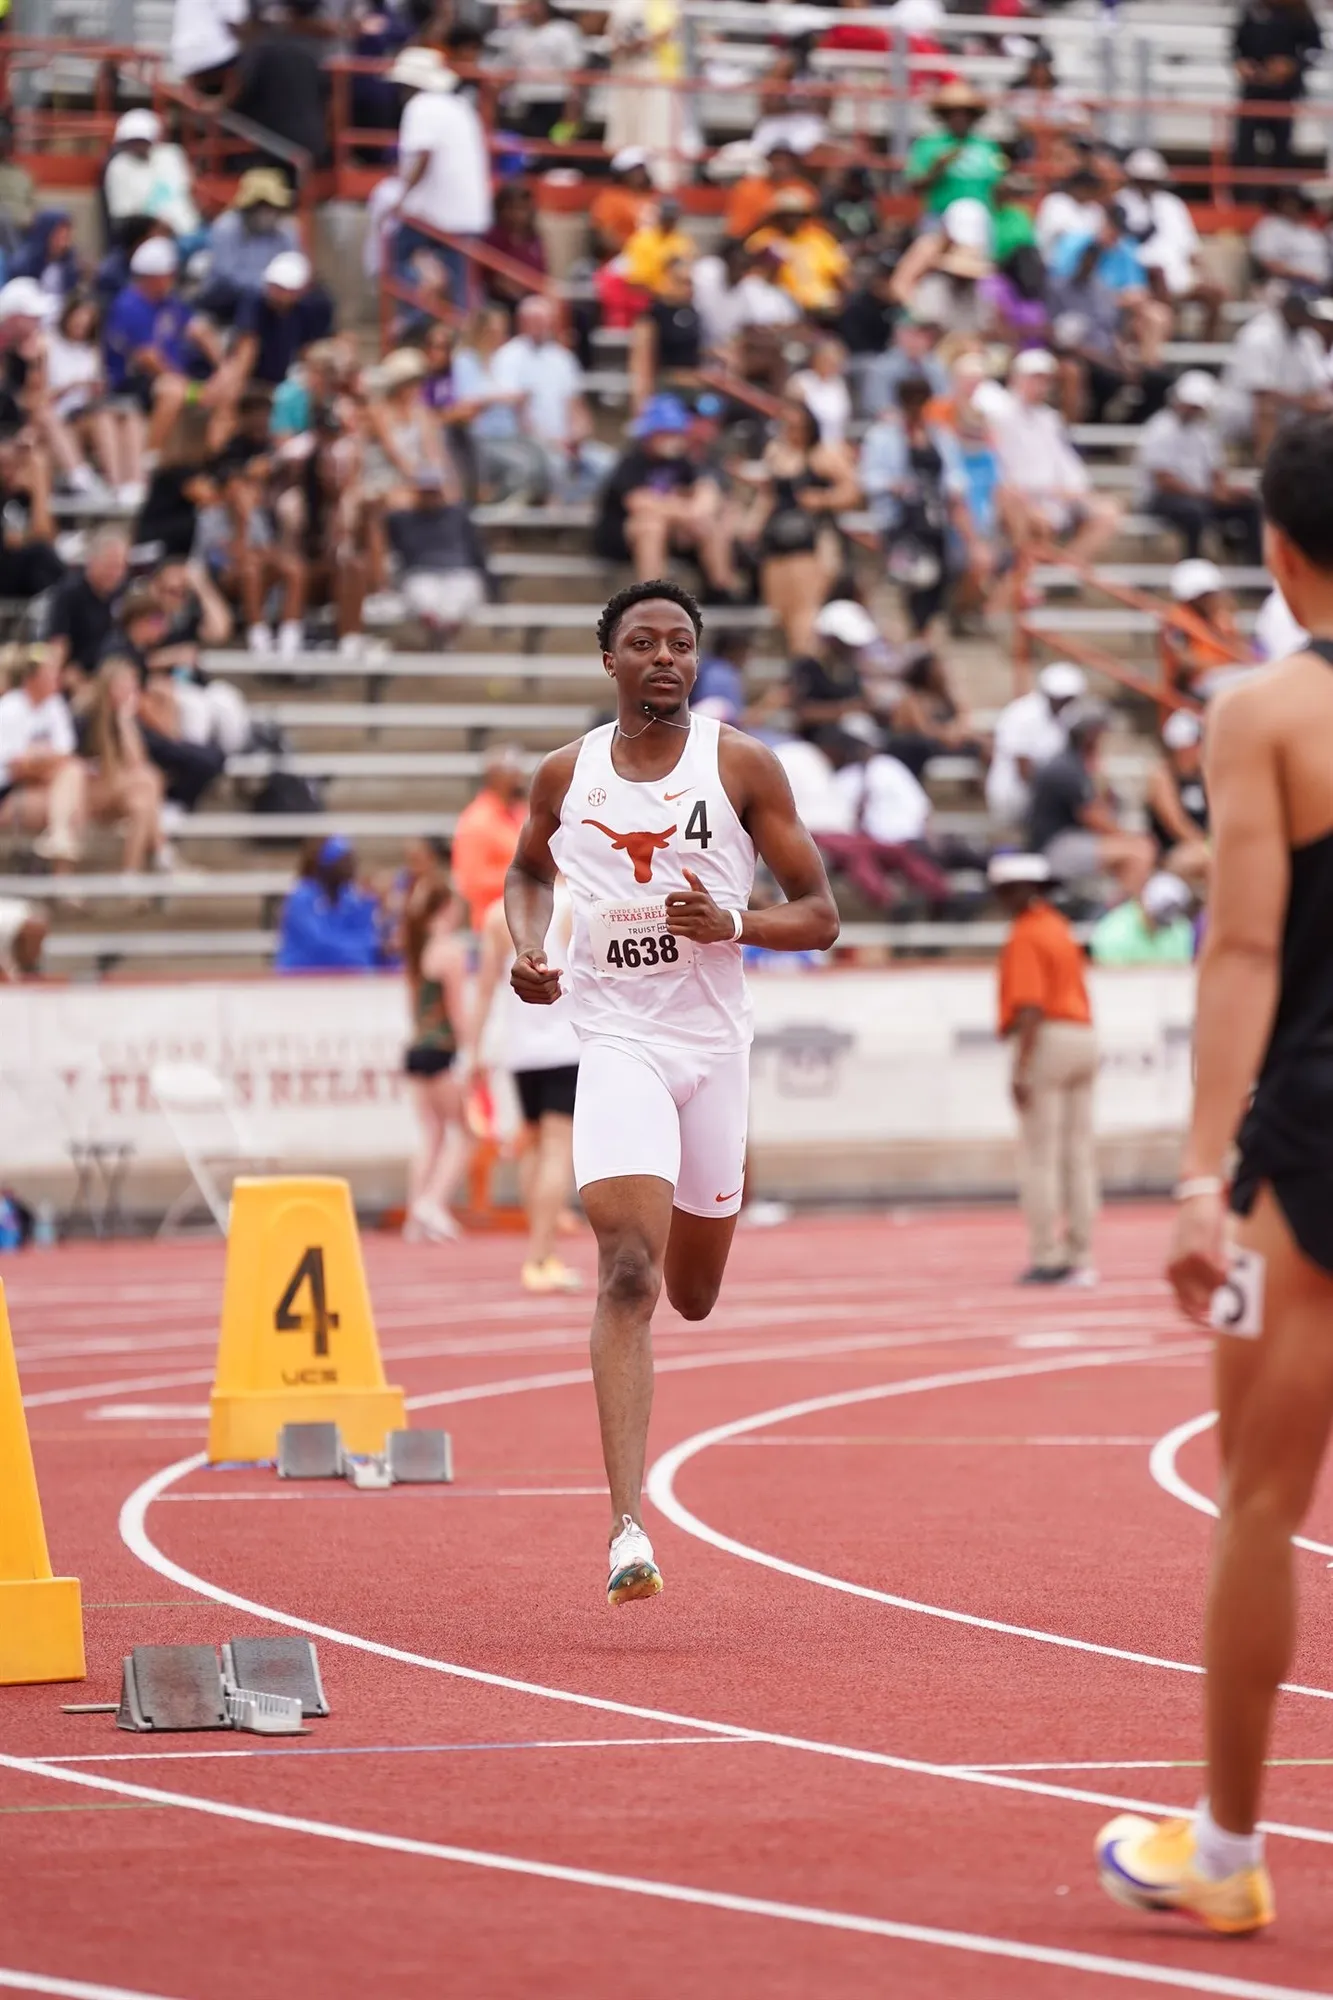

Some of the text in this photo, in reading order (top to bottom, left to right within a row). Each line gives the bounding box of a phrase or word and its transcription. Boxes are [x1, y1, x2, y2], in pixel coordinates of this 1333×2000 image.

[588, 788, 607, 806] SEC
[684, 800, 712, 849] 4
[609, 913, 643, 922] TEXAS
[644, 910, 668, 920] REL
[628, 925, 656, 935] TRUIST
[606, 934, 679, 968] 4638
[274, 1246, 340, 1357] 4
[281, 1369, 339, 1385] UCS
